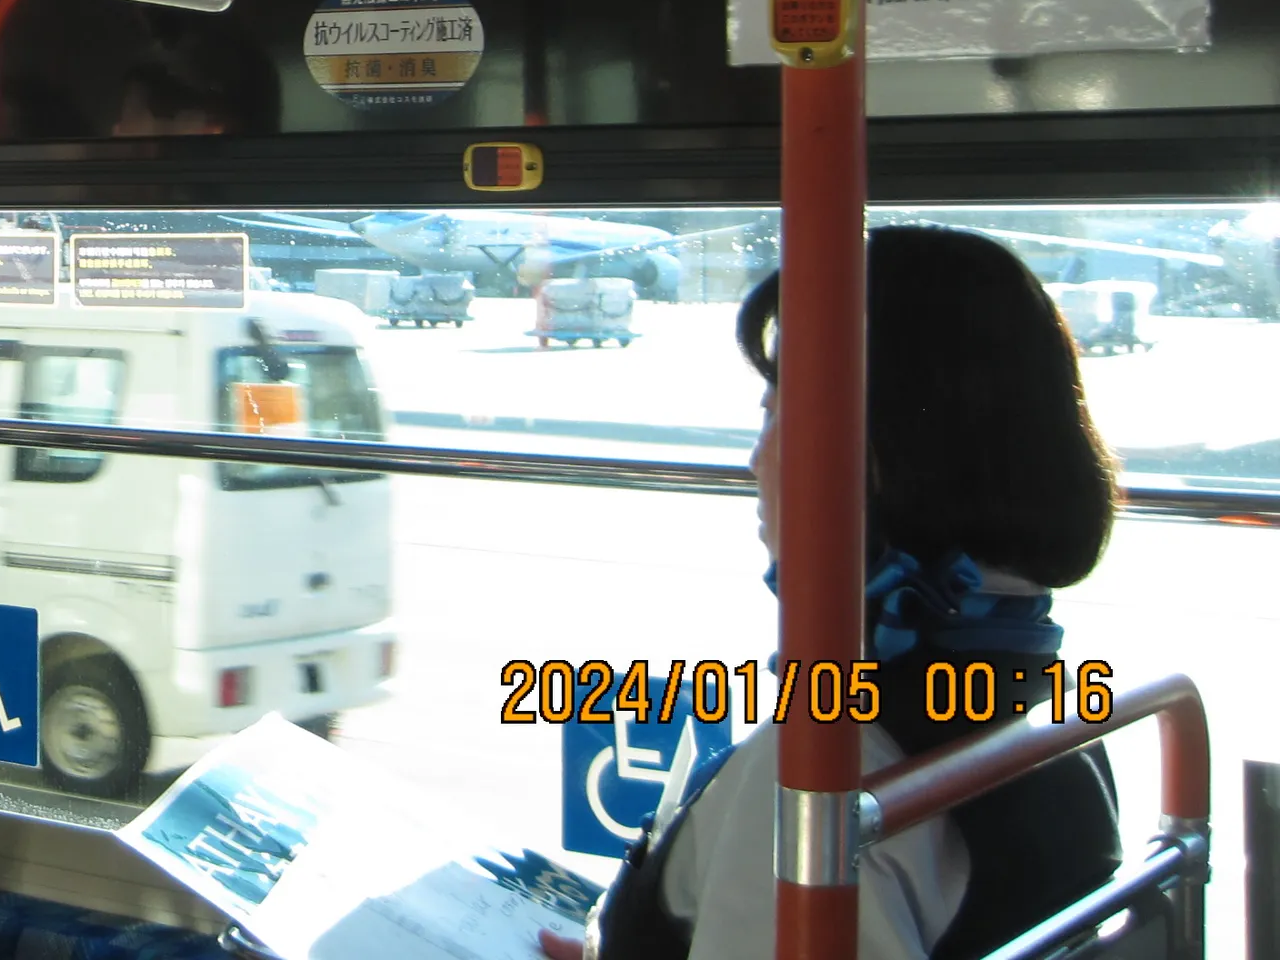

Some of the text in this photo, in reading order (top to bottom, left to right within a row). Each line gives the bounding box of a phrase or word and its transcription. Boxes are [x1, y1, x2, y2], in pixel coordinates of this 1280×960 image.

[314, 15, 473, 46] 抗ウイルスコーティング施工済
[344, 57, 437, 79] 抗菌・消臭
